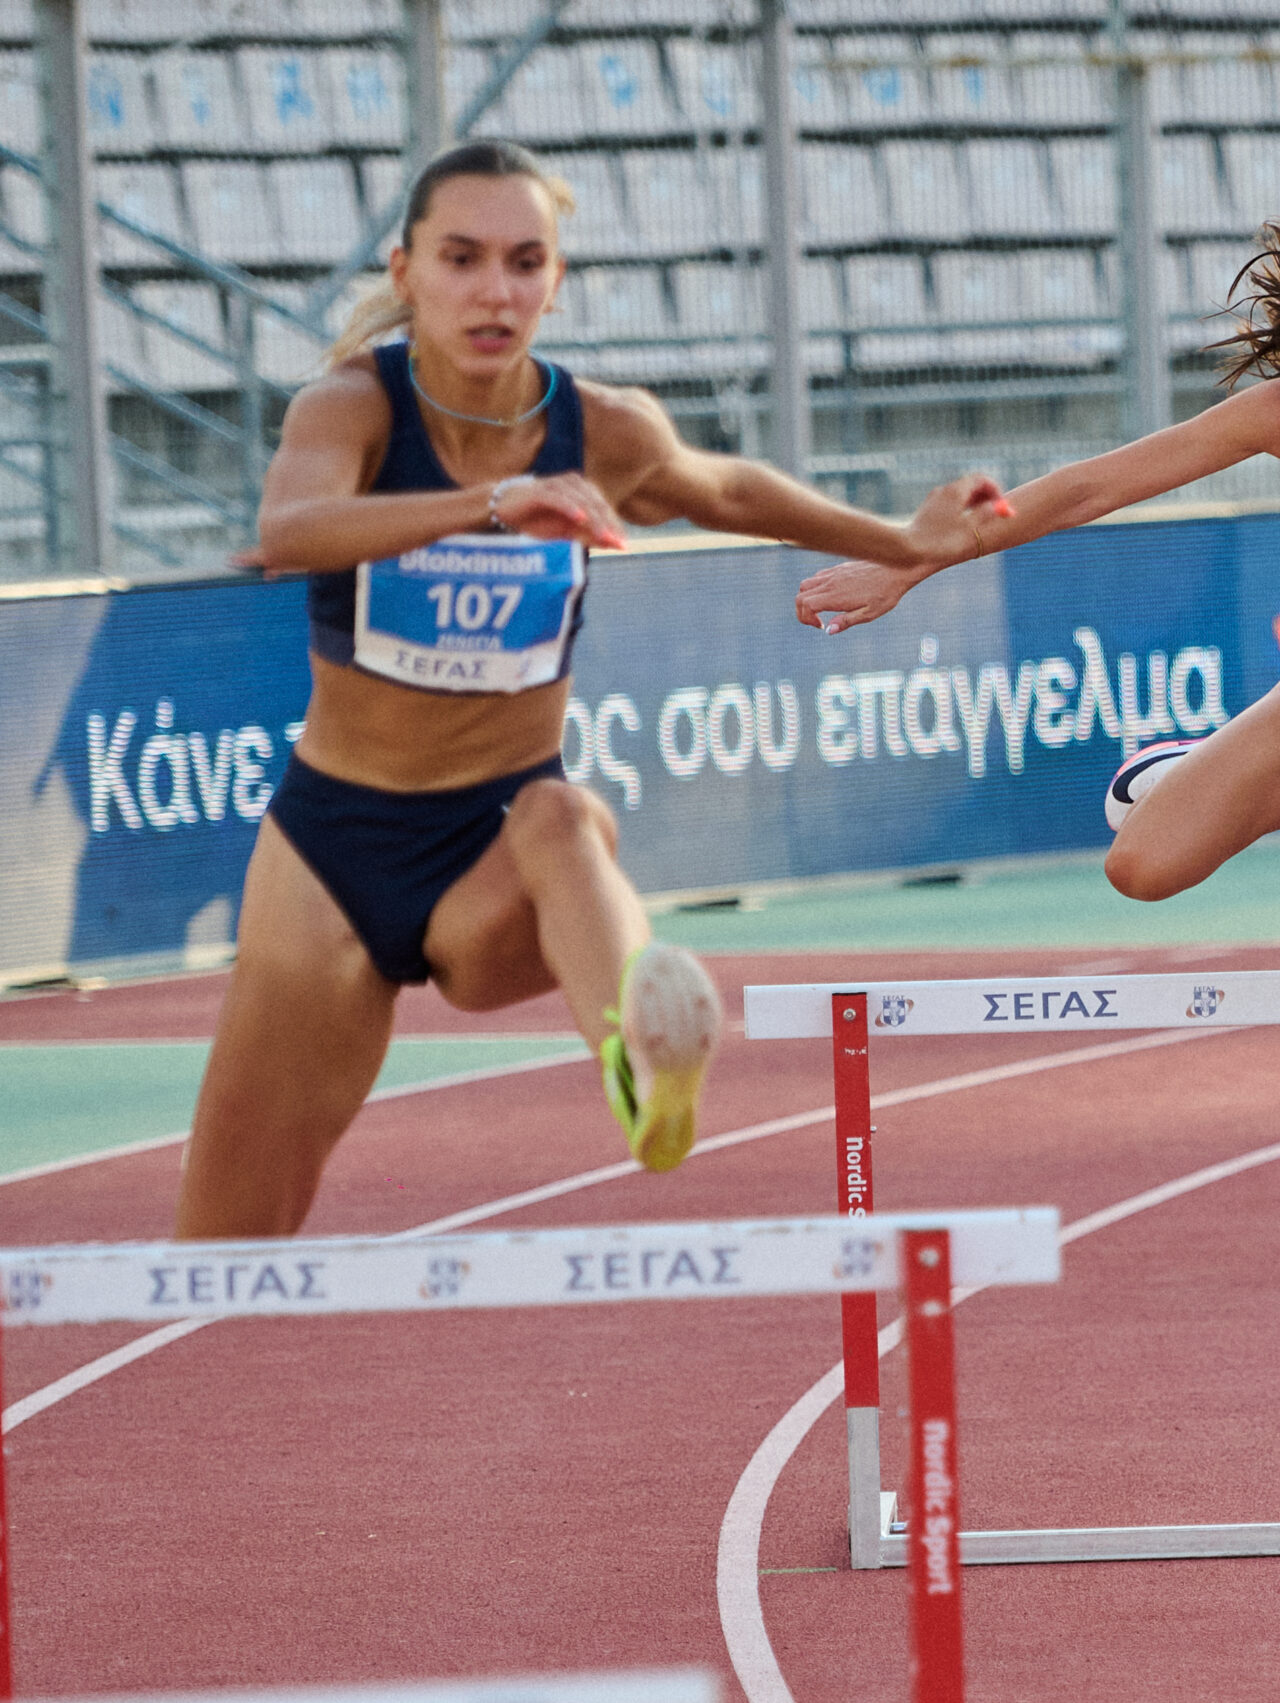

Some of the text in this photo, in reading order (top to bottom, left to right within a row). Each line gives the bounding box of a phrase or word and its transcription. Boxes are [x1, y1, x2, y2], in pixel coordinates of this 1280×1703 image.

[427, 581, 523, 630] 107
[396, 650, 488, 680] ΣΕΓΑΣ
[87, 696, 275, 834] Κάνε
[658, 682, 800, 778] σου
[816, 627, 1229, 778] επάγγελμα
[983, 989, 1119, 1021] ΣΕΓΑΣ
[149, 1247, 743, 1304] ΣΕΓΑΣ ΣΕΓΑΣ
[921, 1516, 953, 1596] Sport
